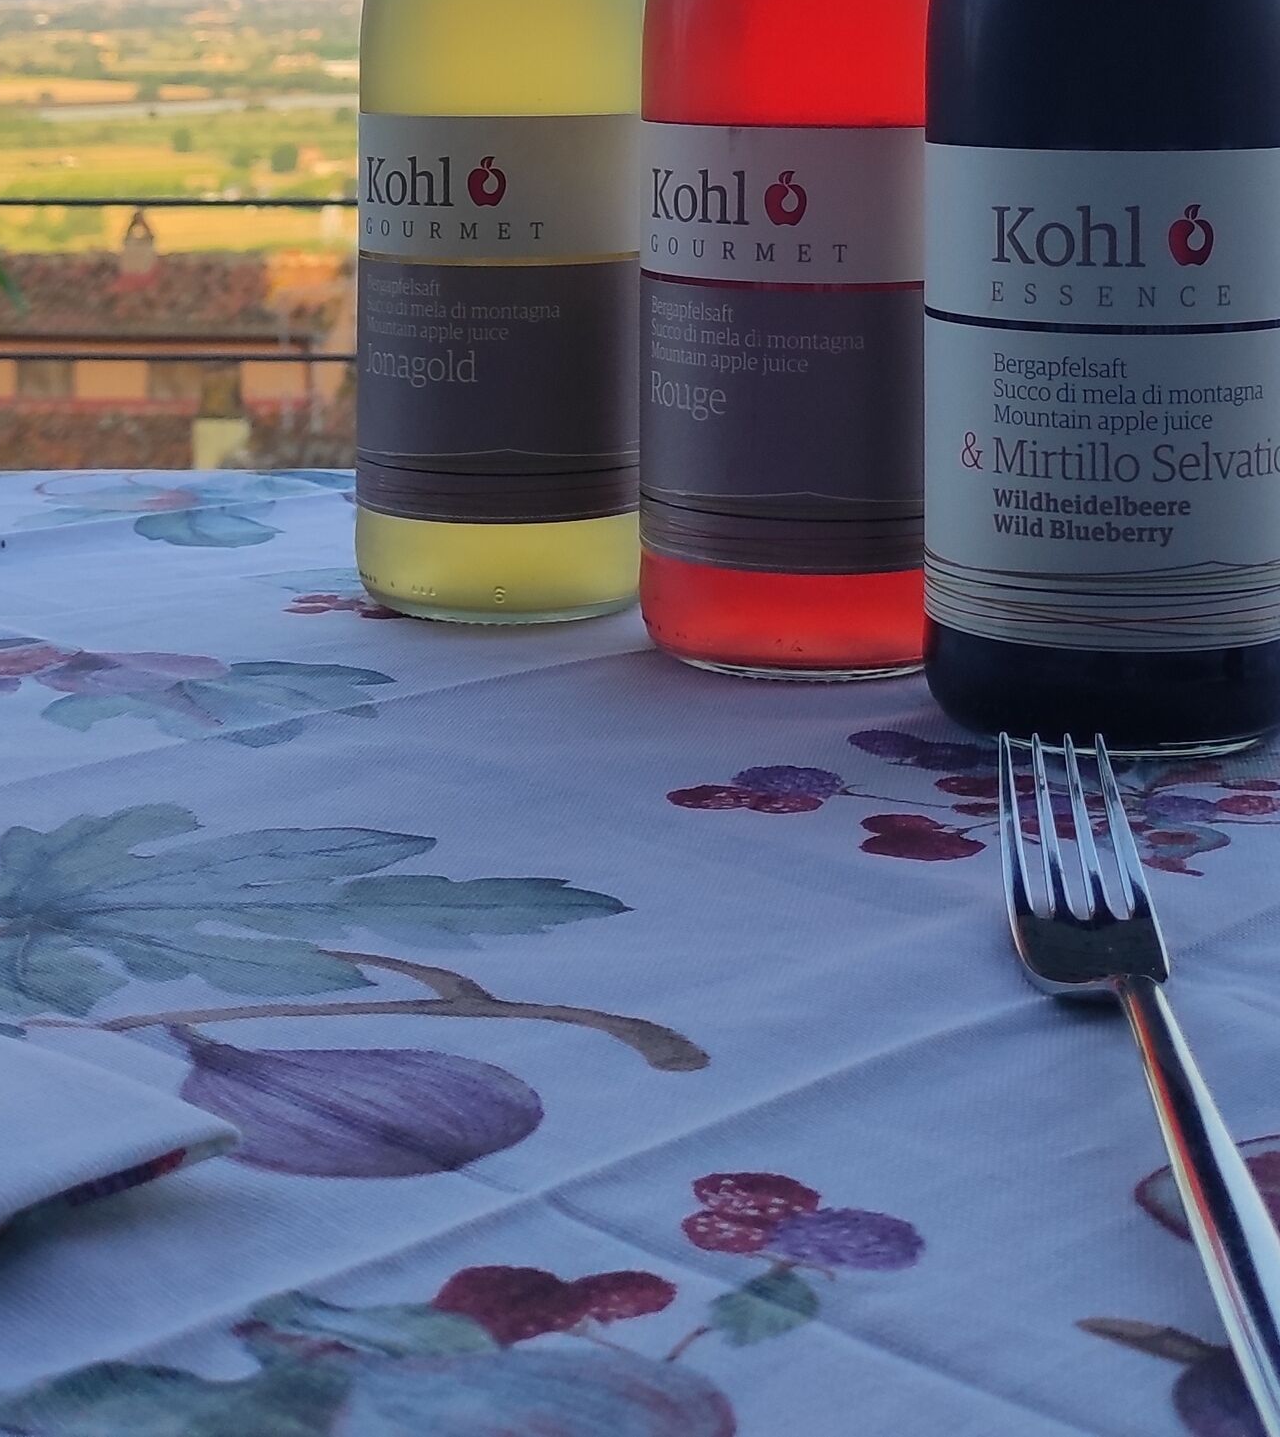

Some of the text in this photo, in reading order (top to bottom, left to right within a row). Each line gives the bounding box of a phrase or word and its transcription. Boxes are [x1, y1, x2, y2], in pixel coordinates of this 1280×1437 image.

[366, 156, 455, 207] Kohl
[651, 168, 750, 225] Kohl
[365, 217, 545, 240] GOURMET
[991, 205, 1146, 268] Kohl
[650, 234, 848, 263] GOURMET
[651, 295, 735, 324] Bergapfelsaft
[991, 281, 1233, 307] ESSENCE
[410, 301, 447, 318] mela
[450, 301, 467, 319] di
[470, 303, 561, 323] montagna
[420, 322, 464, 344] apple
[466, 325, 510, 345] juice
[651, 317, 866, 355] Succo di mela di montagna
[365, 342, 479, 389] Jonagold
[651, 340, 809, 376] Mountain apple juice
[993, 352, 1128, 381] Bergapfelsaft
[651, 370, 727, 422] Rouge
[993, 378, 1264, 407] Succo di mela di montagna
[993, 404, 1214, 436] Mountain apple juice
[961, 431, 984, 471] &
[992, 436, 1141, 483] Mirtillo
[992, 488, 1192, 516] Wildheidelbeere
[992, 514, 1174, 548] Wild Blueberry
